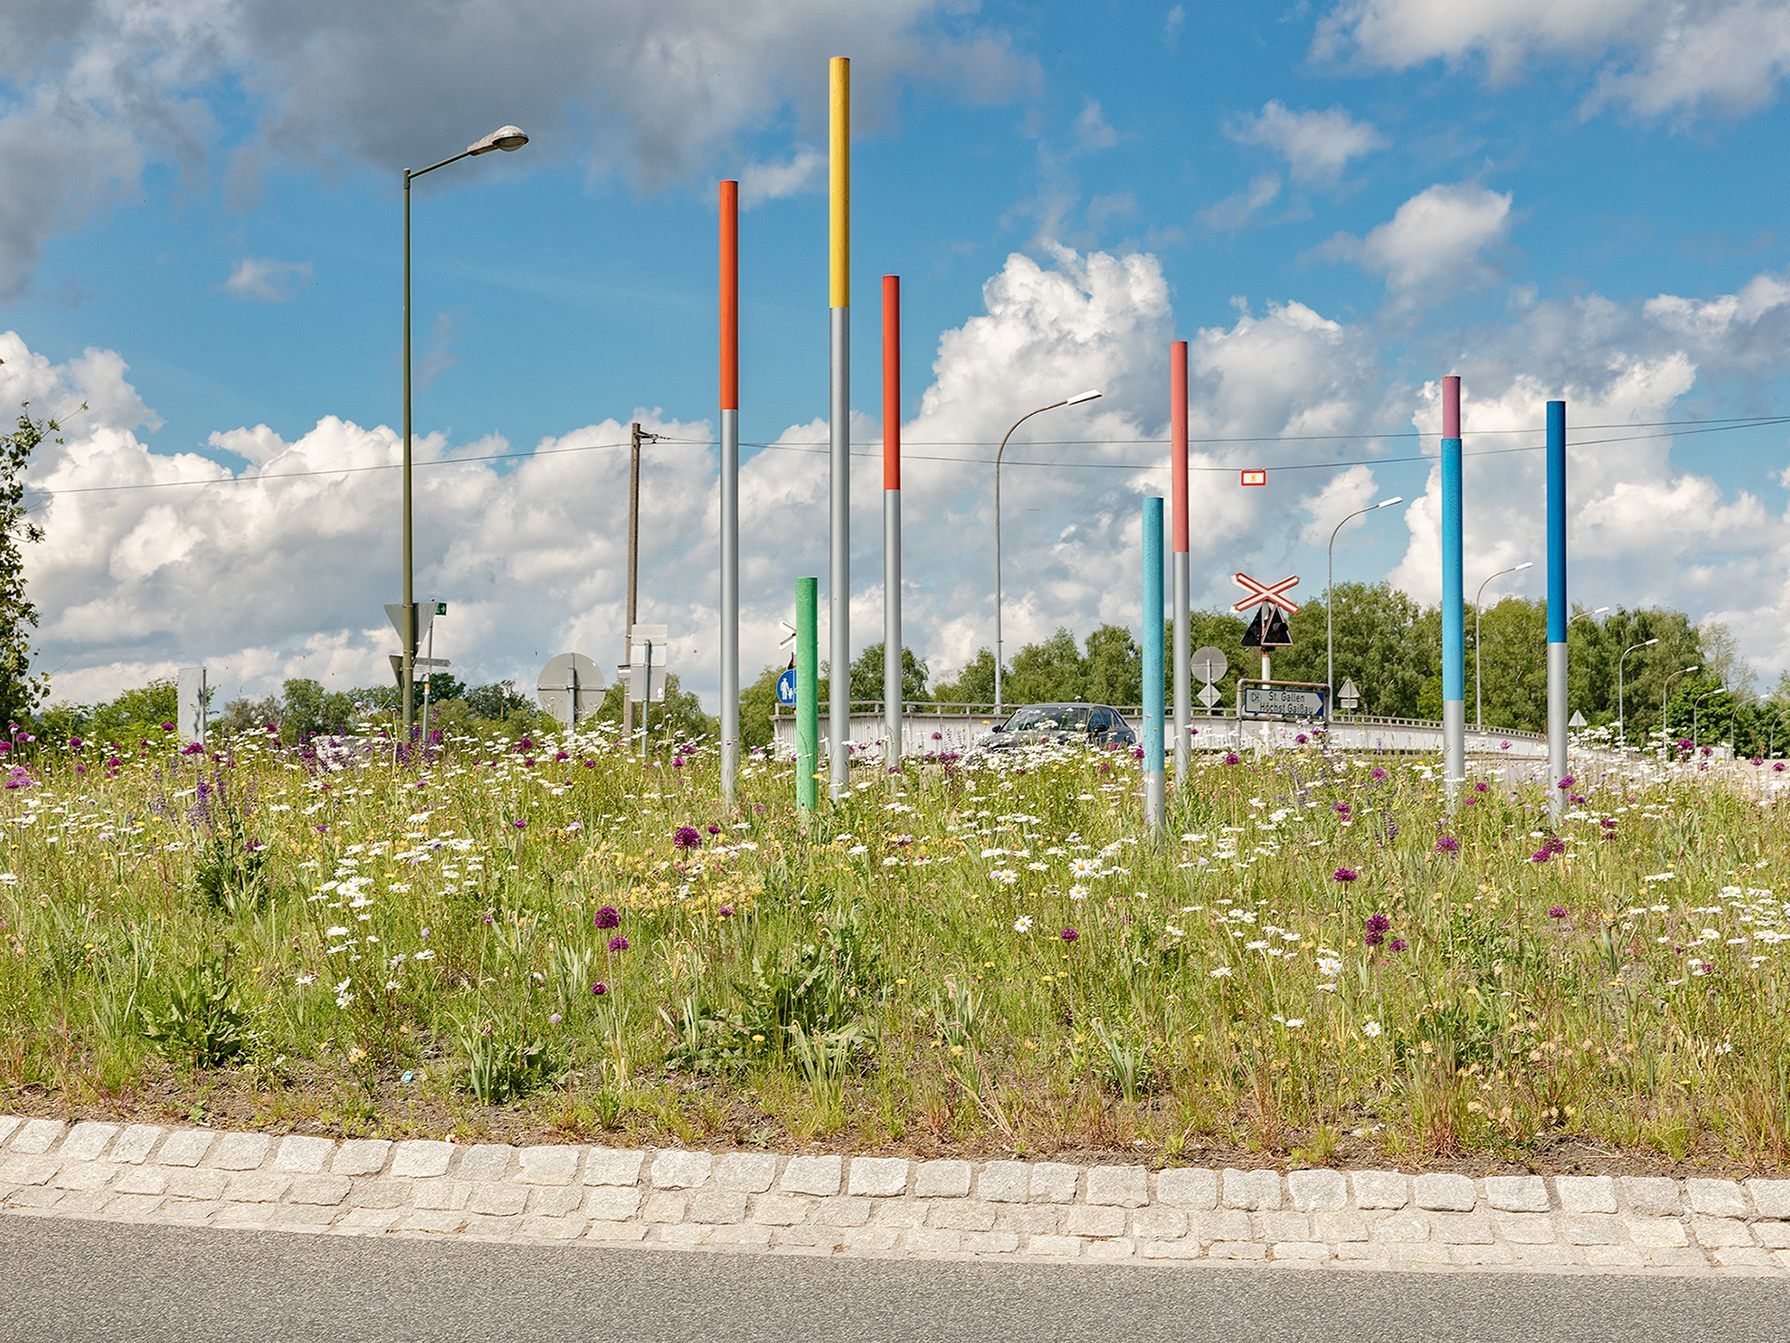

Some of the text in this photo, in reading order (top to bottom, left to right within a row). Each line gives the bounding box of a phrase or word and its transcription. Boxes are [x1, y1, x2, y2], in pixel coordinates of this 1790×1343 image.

[1268, 691, 1305, 702] St. Gallen
[1260, 702, 1313, 714] Höchst Gaißau
